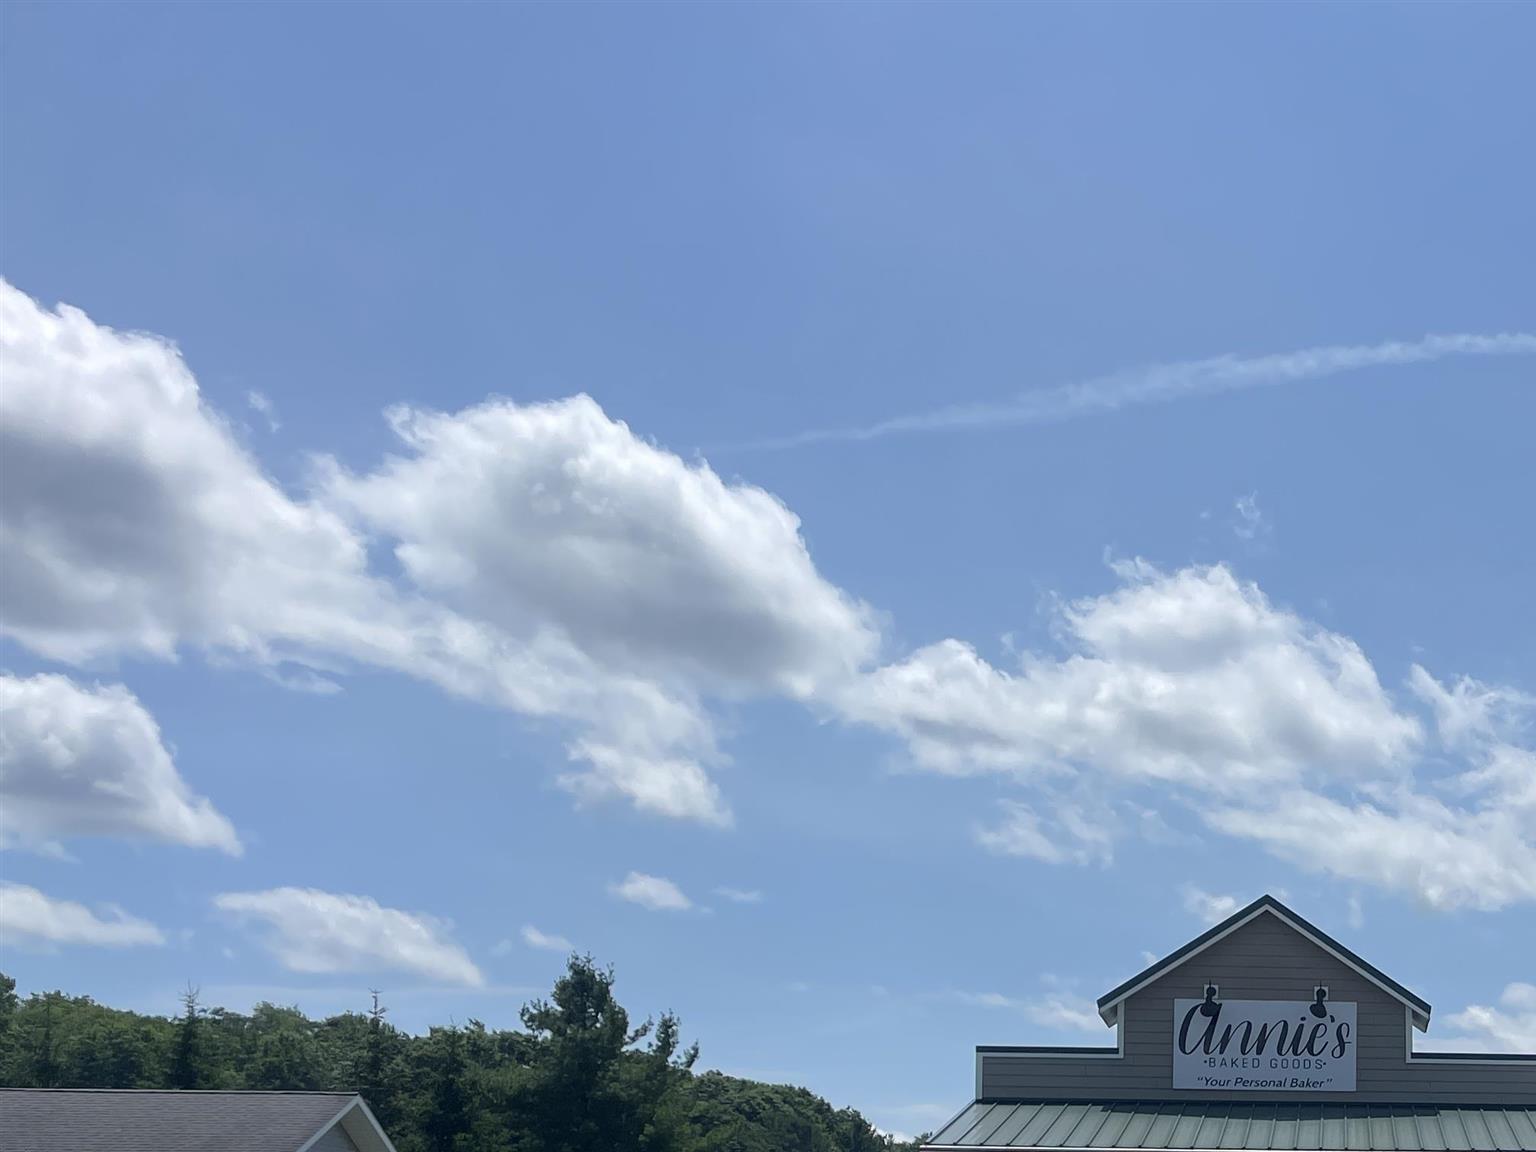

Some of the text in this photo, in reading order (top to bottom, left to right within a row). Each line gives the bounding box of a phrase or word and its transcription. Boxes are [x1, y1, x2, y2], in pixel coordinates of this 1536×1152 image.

[1208, 1057, 1324, 1070] BAKED GOODS
[1234, 1077, 1287, 1088] Personal
